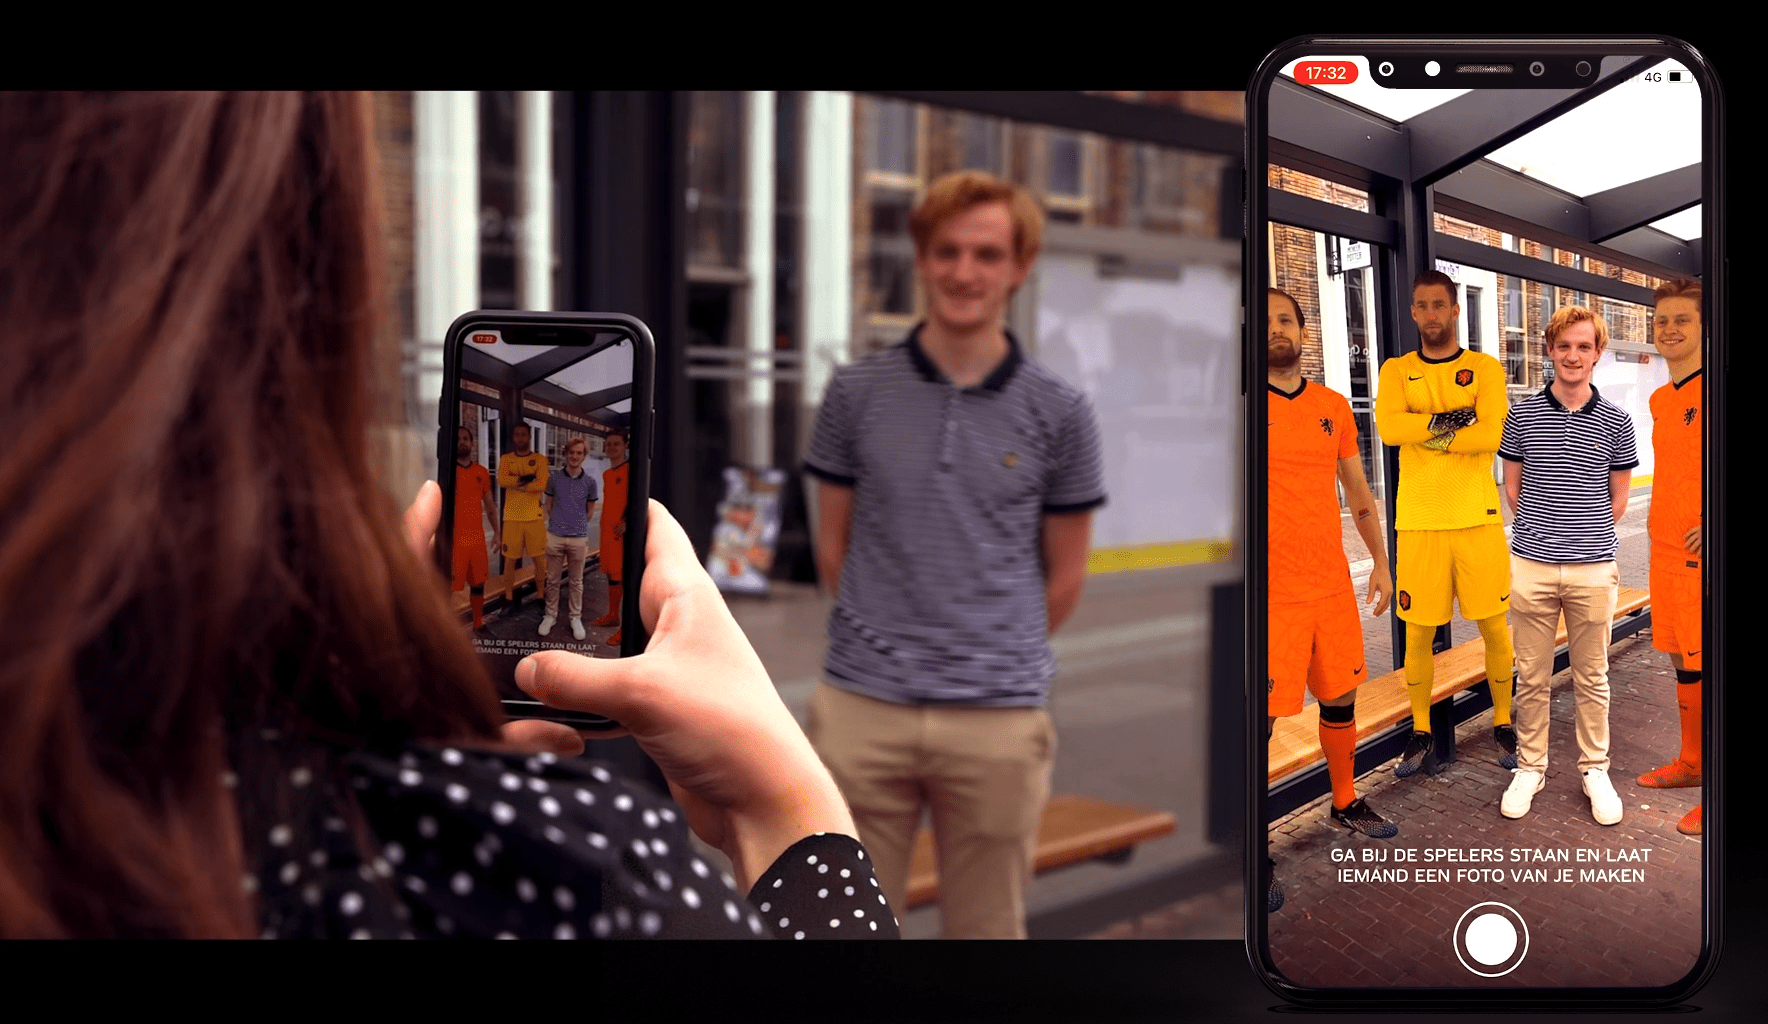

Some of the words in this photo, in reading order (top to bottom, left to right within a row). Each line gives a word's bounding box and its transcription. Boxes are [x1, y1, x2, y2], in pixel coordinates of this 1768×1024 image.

[1305, 66, 1347, 80] 17:32
[1644, 72, 1662, 82] 4G
[507, 640, 540, 648] SPELERS
[1330, 848, 1356, 862] GA
[1362, 848, 1387, 862] BIJ
[1394, 848, 1418, 862] DE
[1423, 848, 1504, 862] SPELERS
[1510, 848, 1569, 862] STAAN
[1576, 848, 1600, 862] EN
[1606, 848, 1653, 862] LAAT
[1338, 868, 1409, 883] IEMAND
[1415, 868, 1450, 883] EEN
[1457, 868, 1505, 883] FOTO
[1510, 868, 1547, 883] VAN
[1553, 868, 1574, 883] JE
[1580, 868, 1645, 883] MAKEN
